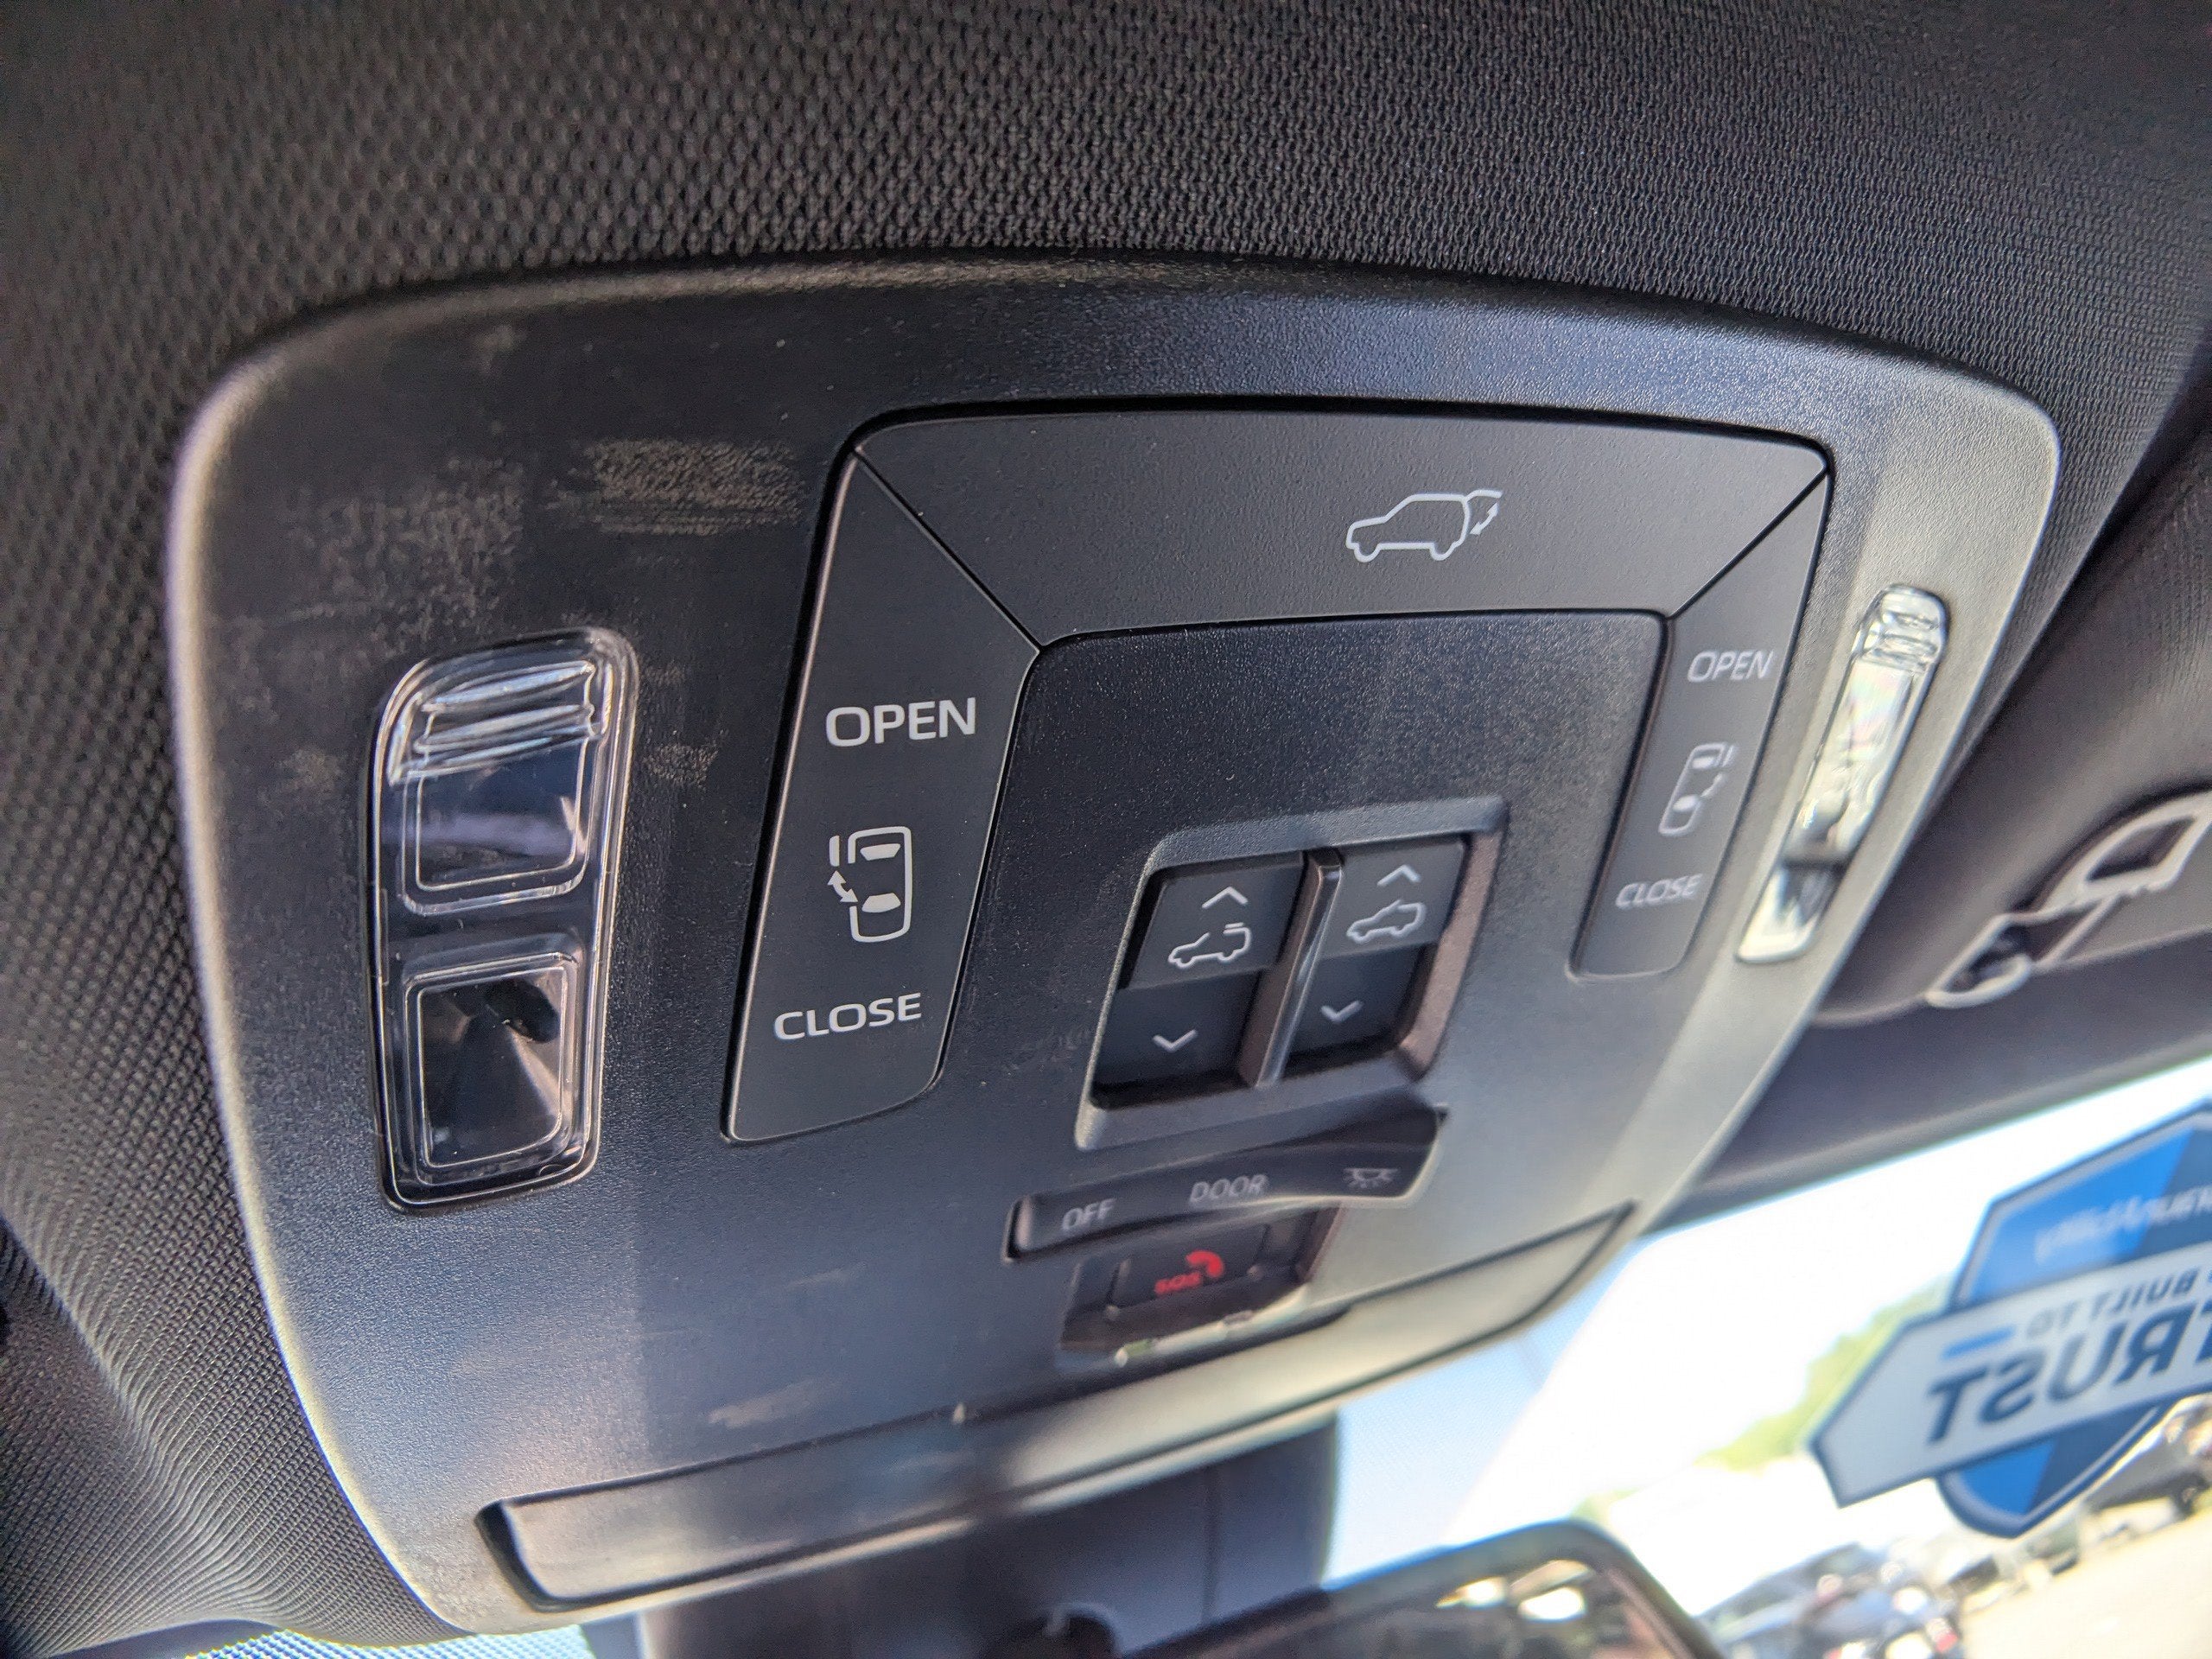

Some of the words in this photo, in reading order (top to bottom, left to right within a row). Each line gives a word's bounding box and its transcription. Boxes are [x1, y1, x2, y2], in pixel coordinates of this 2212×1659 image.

[1688, 651, 1773, 683] OPEN
[826, 697, 976, 747] OPEN
[1616, 873, 1703, 909] CLOSE
[774, 993, 922, 1039] CLOSE
[1189, 1173, 1268, 1205] DOOR
[1061, 1198, 1116, 1231] OFF
